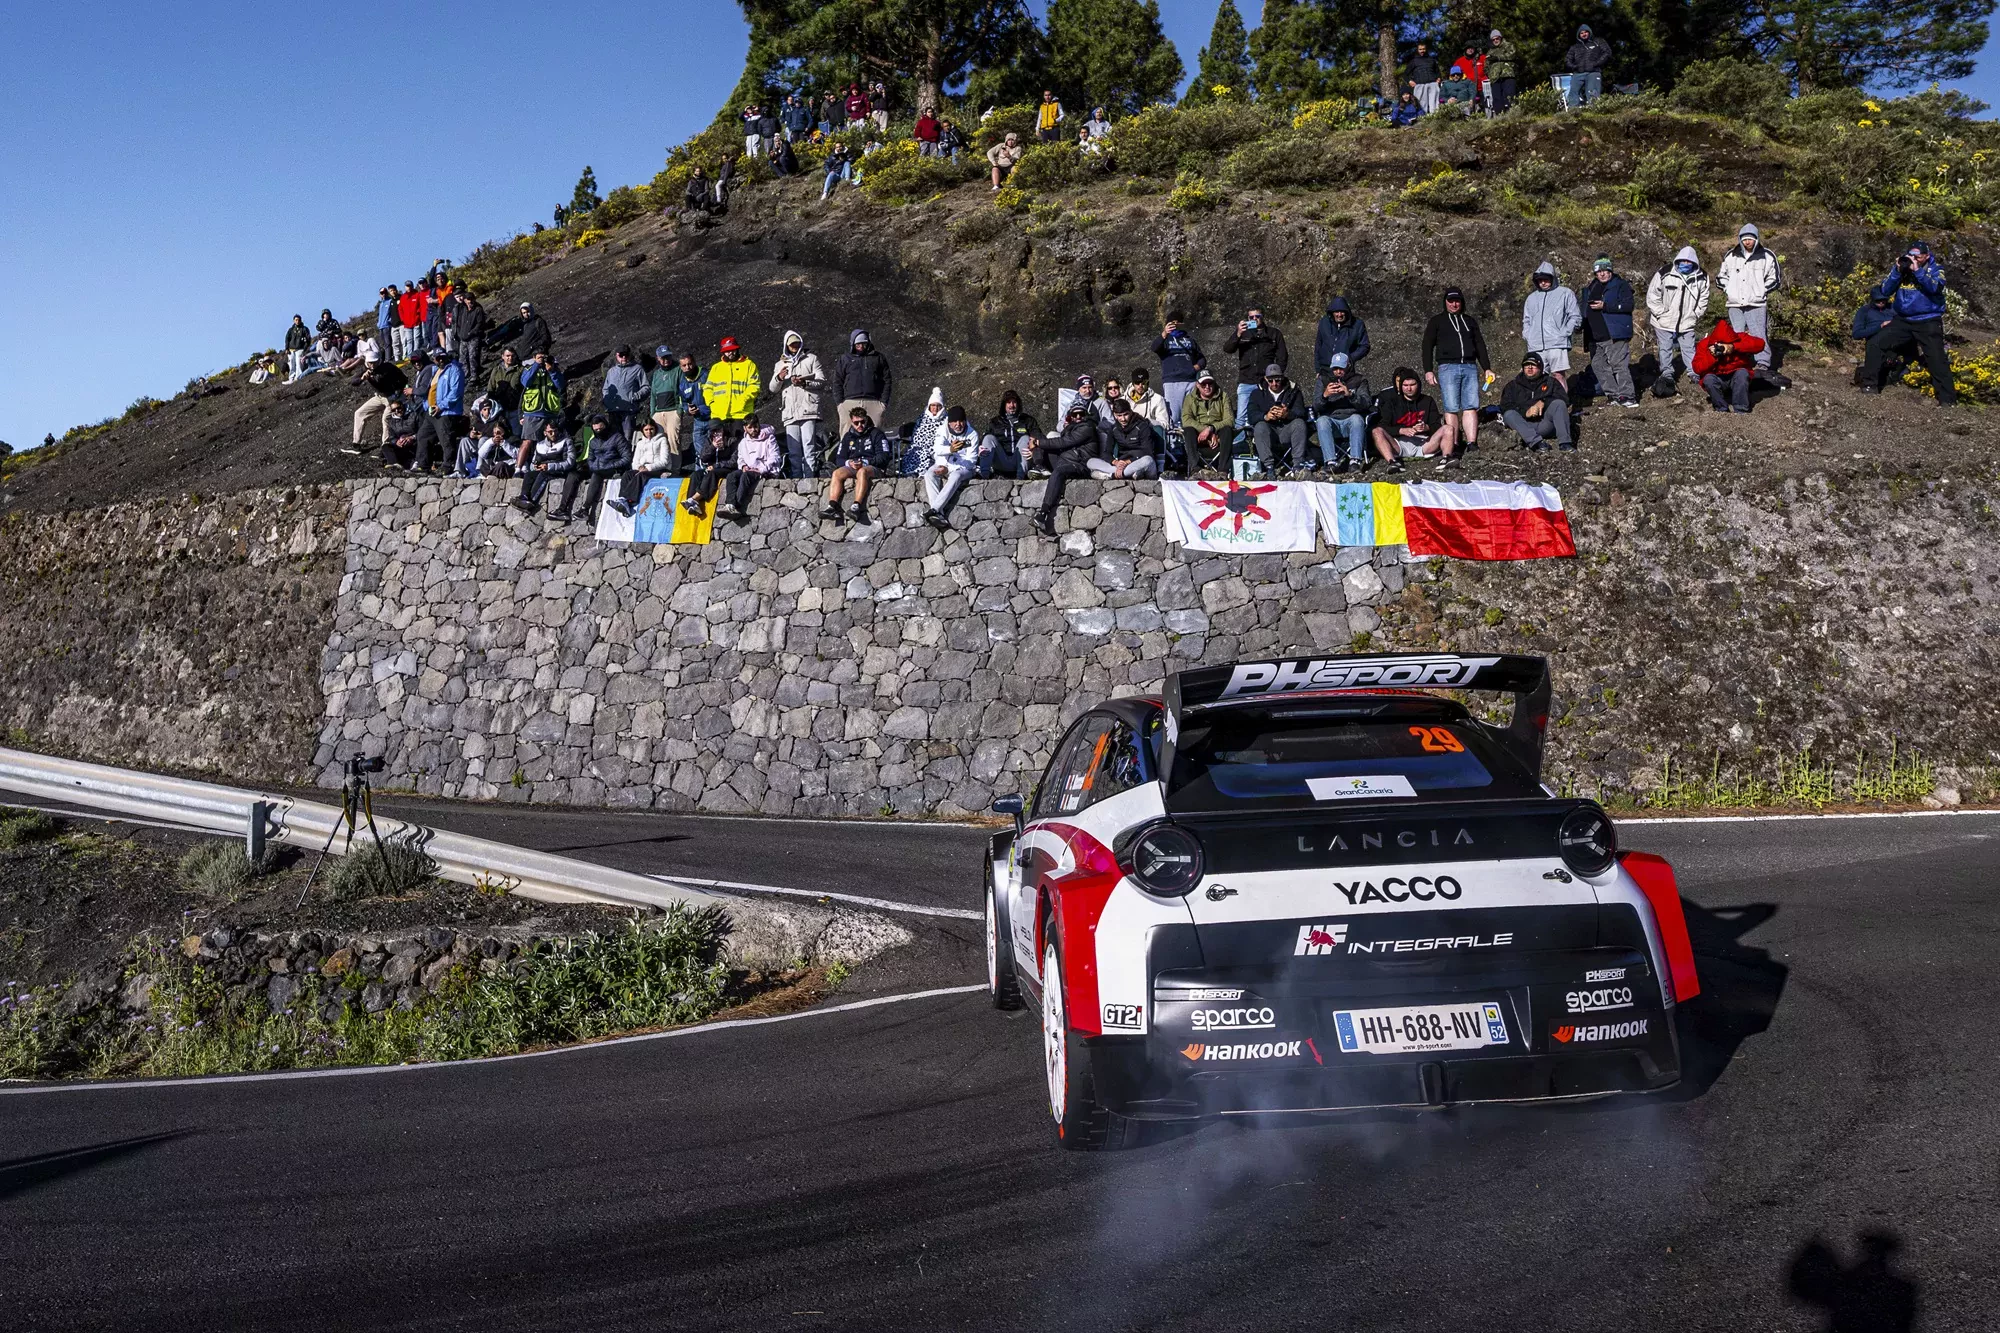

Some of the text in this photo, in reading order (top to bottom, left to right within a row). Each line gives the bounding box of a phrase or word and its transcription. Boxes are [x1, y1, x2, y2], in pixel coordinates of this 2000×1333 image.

[1200, 526, 1265, 543] LANZAROTE
[1408, 726, 1465, 752] 29
[1297, 828, 1474, 852] LANCIA
[1332, 875, 1462, 905] YACCO
[1293, 923, 1514, 956] HF INTEGRALE
[1565, 986, 1634, 1013] sparco
[1103, 1003, 1142, 1027] GT2i
[1190, 1007, 1275, 1032] sparco
[1345, 1011, 1505, 1045] F HH-688-NV 52
